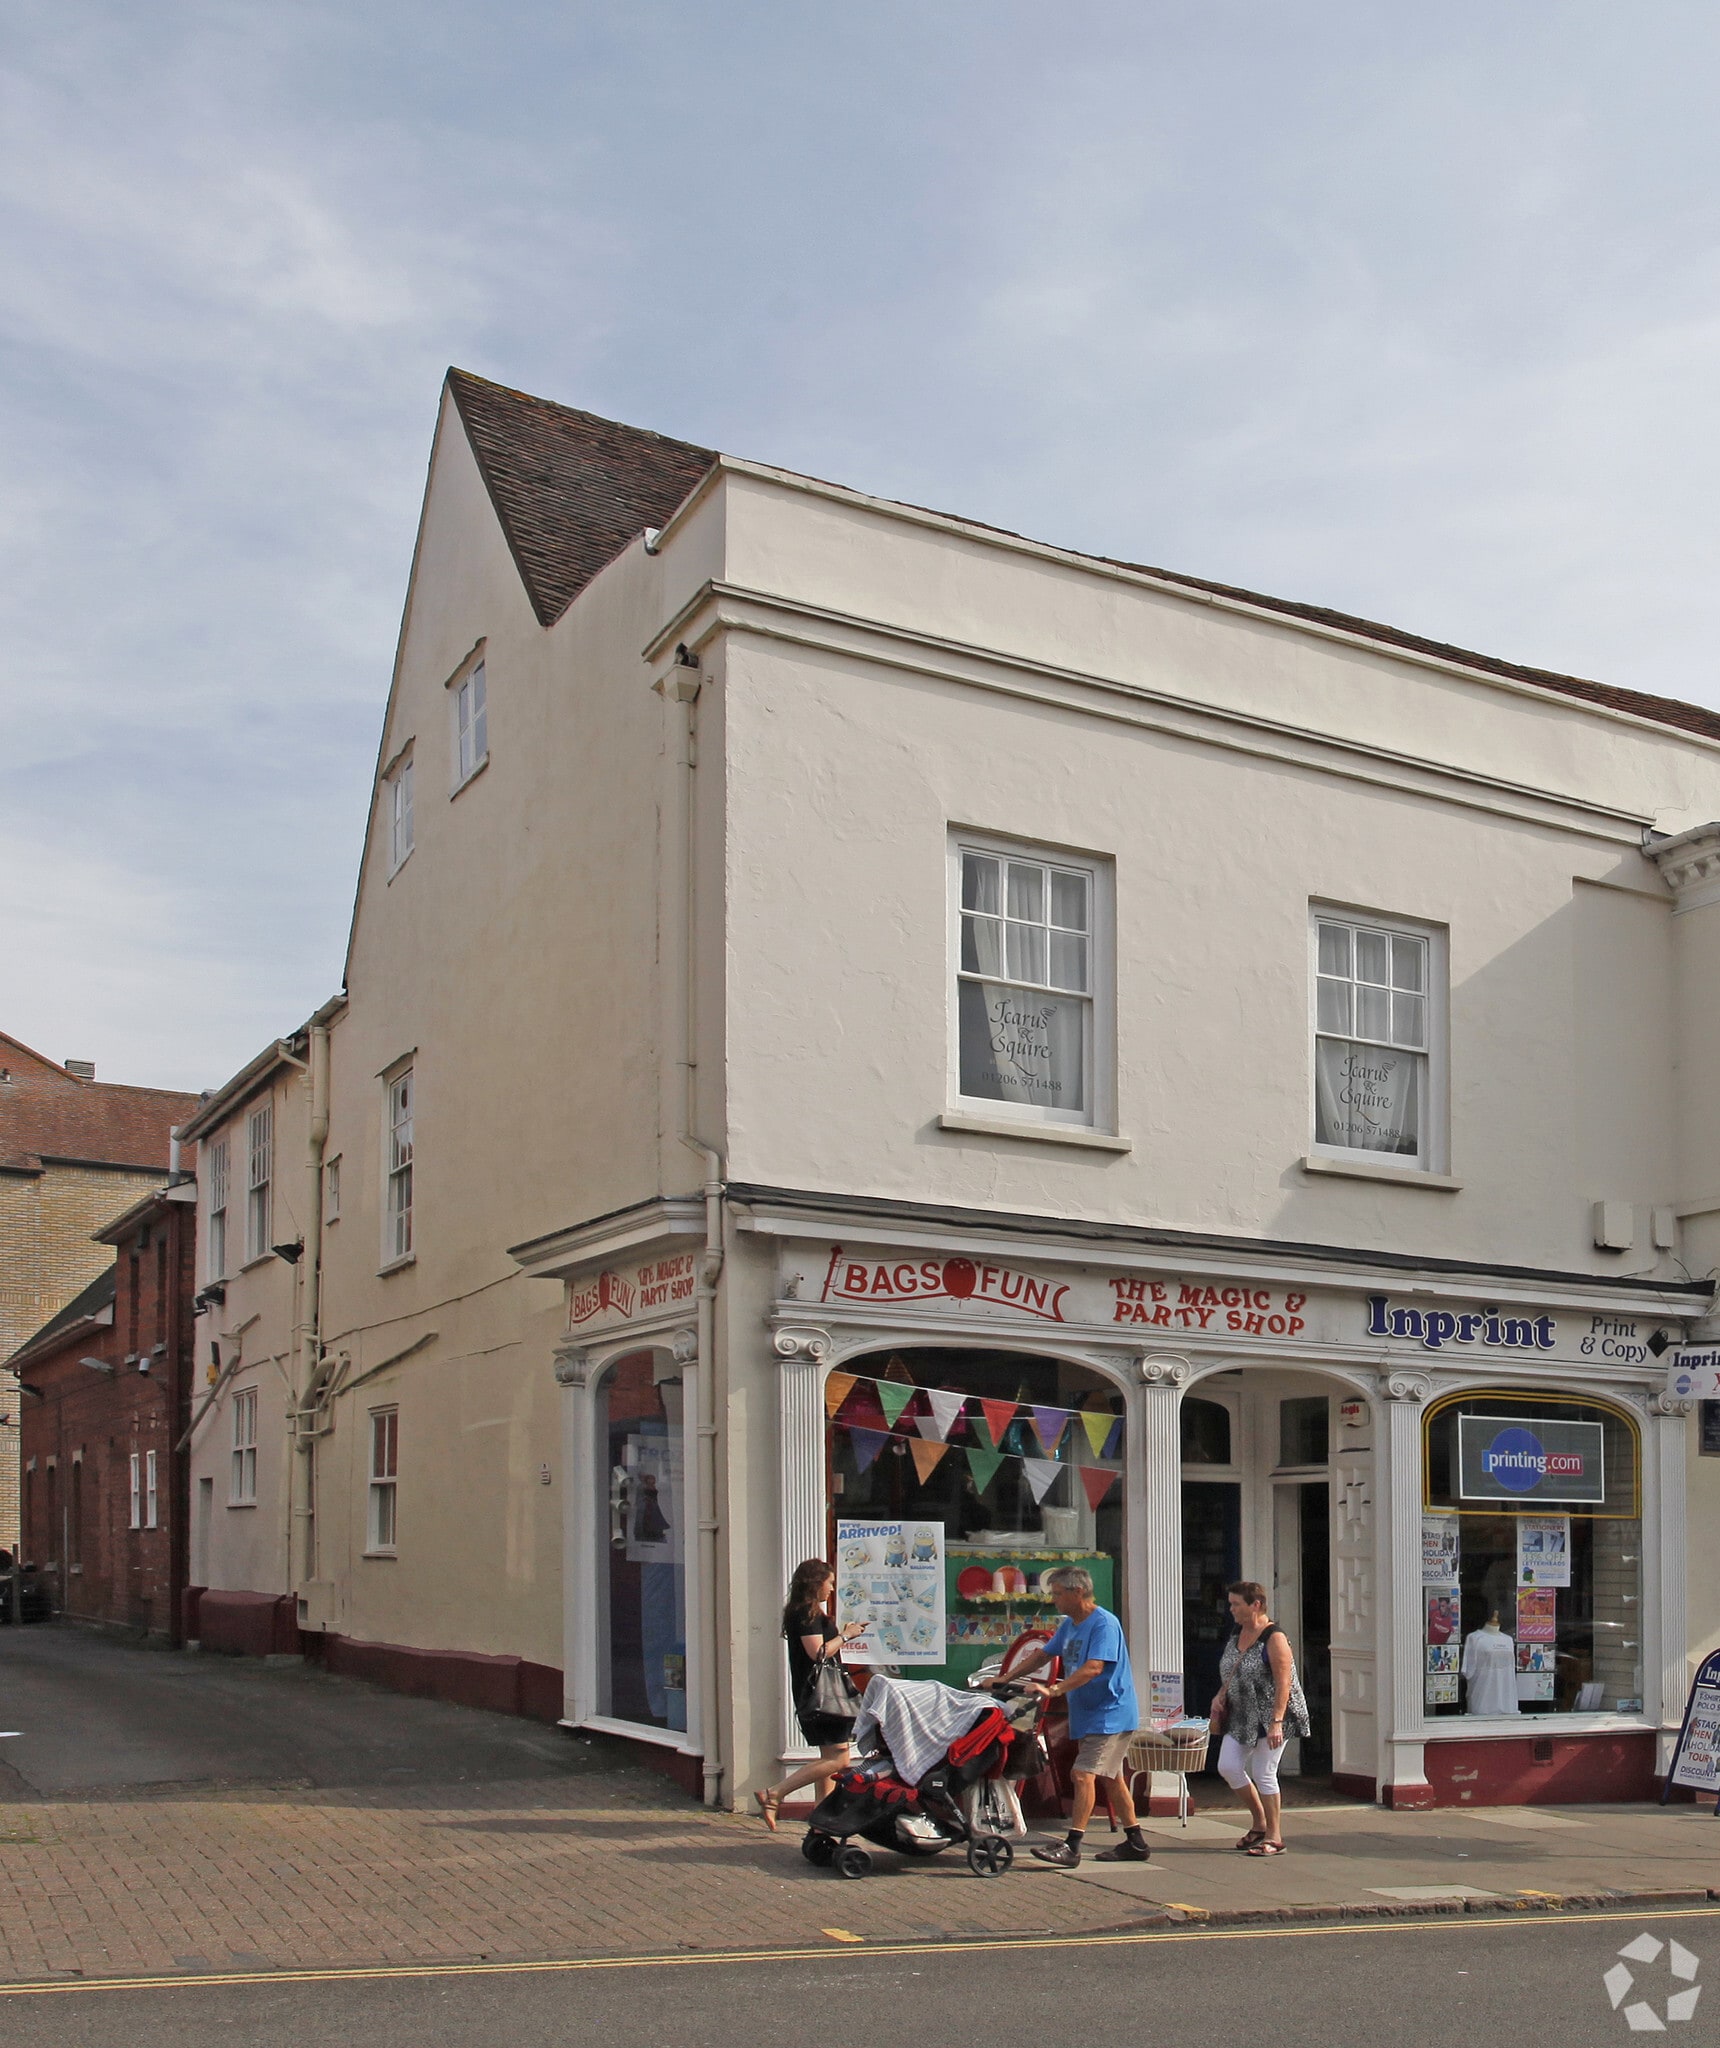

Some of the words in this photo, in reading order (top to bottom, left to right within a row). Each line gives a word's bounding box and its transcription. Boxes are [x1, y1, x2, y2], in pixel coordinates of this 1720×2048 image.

[990, 999, 1057, 1029] Icarus
[982, 1071, 1017, 1086] 01206
[1021, 1076, 1062, 1091] 571488
[1340, 1055, 1396, 1082] Icarus
[1333, 1121, 1362, 1133] 01206
[1366, 1126, 1400, 1139] 571488
[638, 1265, 654, 1286] THE
[656, 1257, 684, 1281] MAGIC
[686, 1255, 694, 1273] &
[843, 1262, 942, 1295] BAGS
[574, 1285, 599, 1318] BAGS
[640, 1283, 669, 1309] PARTY
[671, 1276, 694, 1300] SHOP
[1109, 1277, 1168, 1302] THE
[1178, 1283, 1270, 1311] MAGIC
[1285, 1293, 1306, 1313] &
[1113, 1301, 1216, 1329] PARTY
[1226, 1310, 1305, 1336] SHOP
[1367, 1295, 1557, 1350] Inprint
[1590, 1315, 1637, 1337] Print
[1580, 1336, 1595, 1355] &
[1601, 1338, 1648, 1363] Copy
[1488, 1450, 1581, 1474] printing.com
[1423, 1540, 1439, 1548] HEN
[841, 1642, 868, 1650] MEGA
[1697, 1701, 1716, 1711] POLO
[1693, 1729, 1712, 1740] HEN
[1696, 1720, 1717, 1731] STAG
